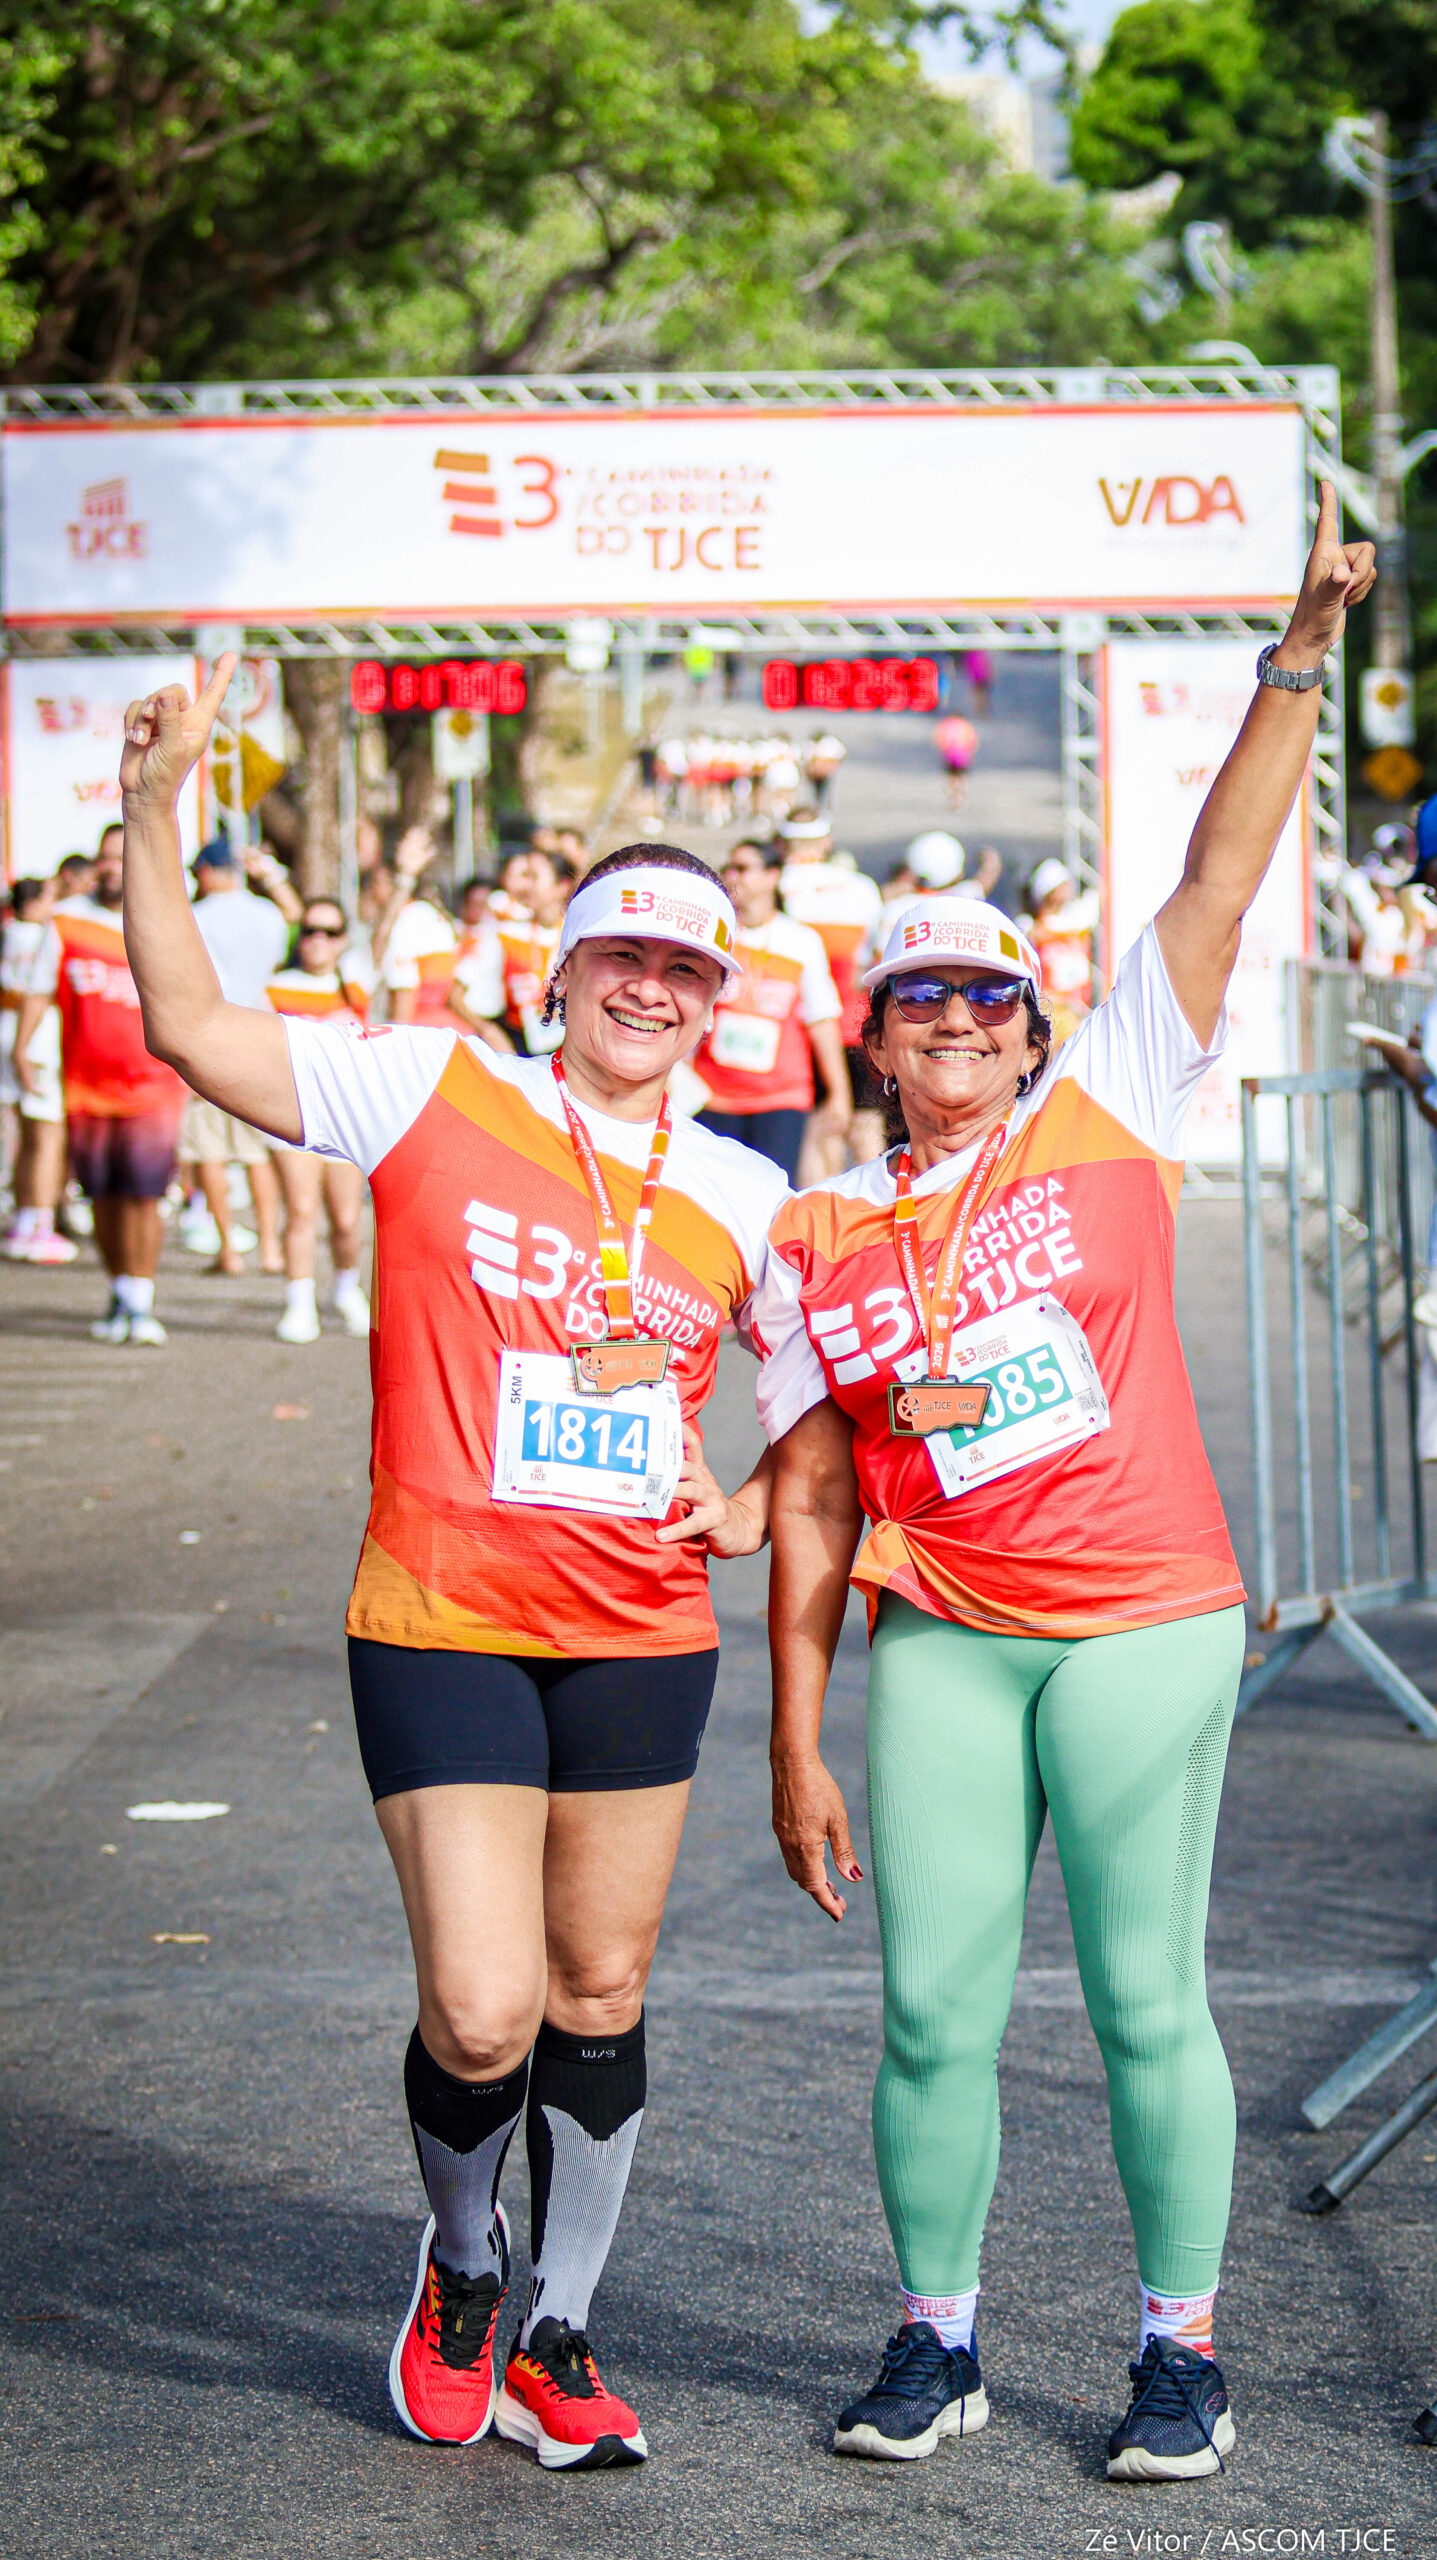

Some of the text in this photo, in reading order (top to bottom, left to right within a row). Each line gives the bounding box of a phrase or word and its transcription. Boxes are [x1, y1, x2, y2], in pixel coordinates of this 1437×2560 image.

[1098, 475, 1244, 527] VIDA
[65, 523, 150, 559] TJCE
[642, 525, 761, 571] TJCE
[662, 896, 712, 918] CAMINHADA
[656, 910, 706, 939] DO TJCE
[937, 920, 991, 932] CAMINHADA
[933, 936, 988, 952] DO TJCE
[966, 1226, 1083, 1314] TJCE
[564, 1301, 609, 1341] DO
[932, 1342, 945, 1369] 2026
[510, 1375, 523, 1405] 5KM
[961, 1348, 1065, 1439] 085
[933, 1401, 952, 1410] TJCE
[528, 1405, 647, 1470] 1814
[968, 1453, 986, 1465] TJCE
[530, 1473, 547, 1482] TJCE
